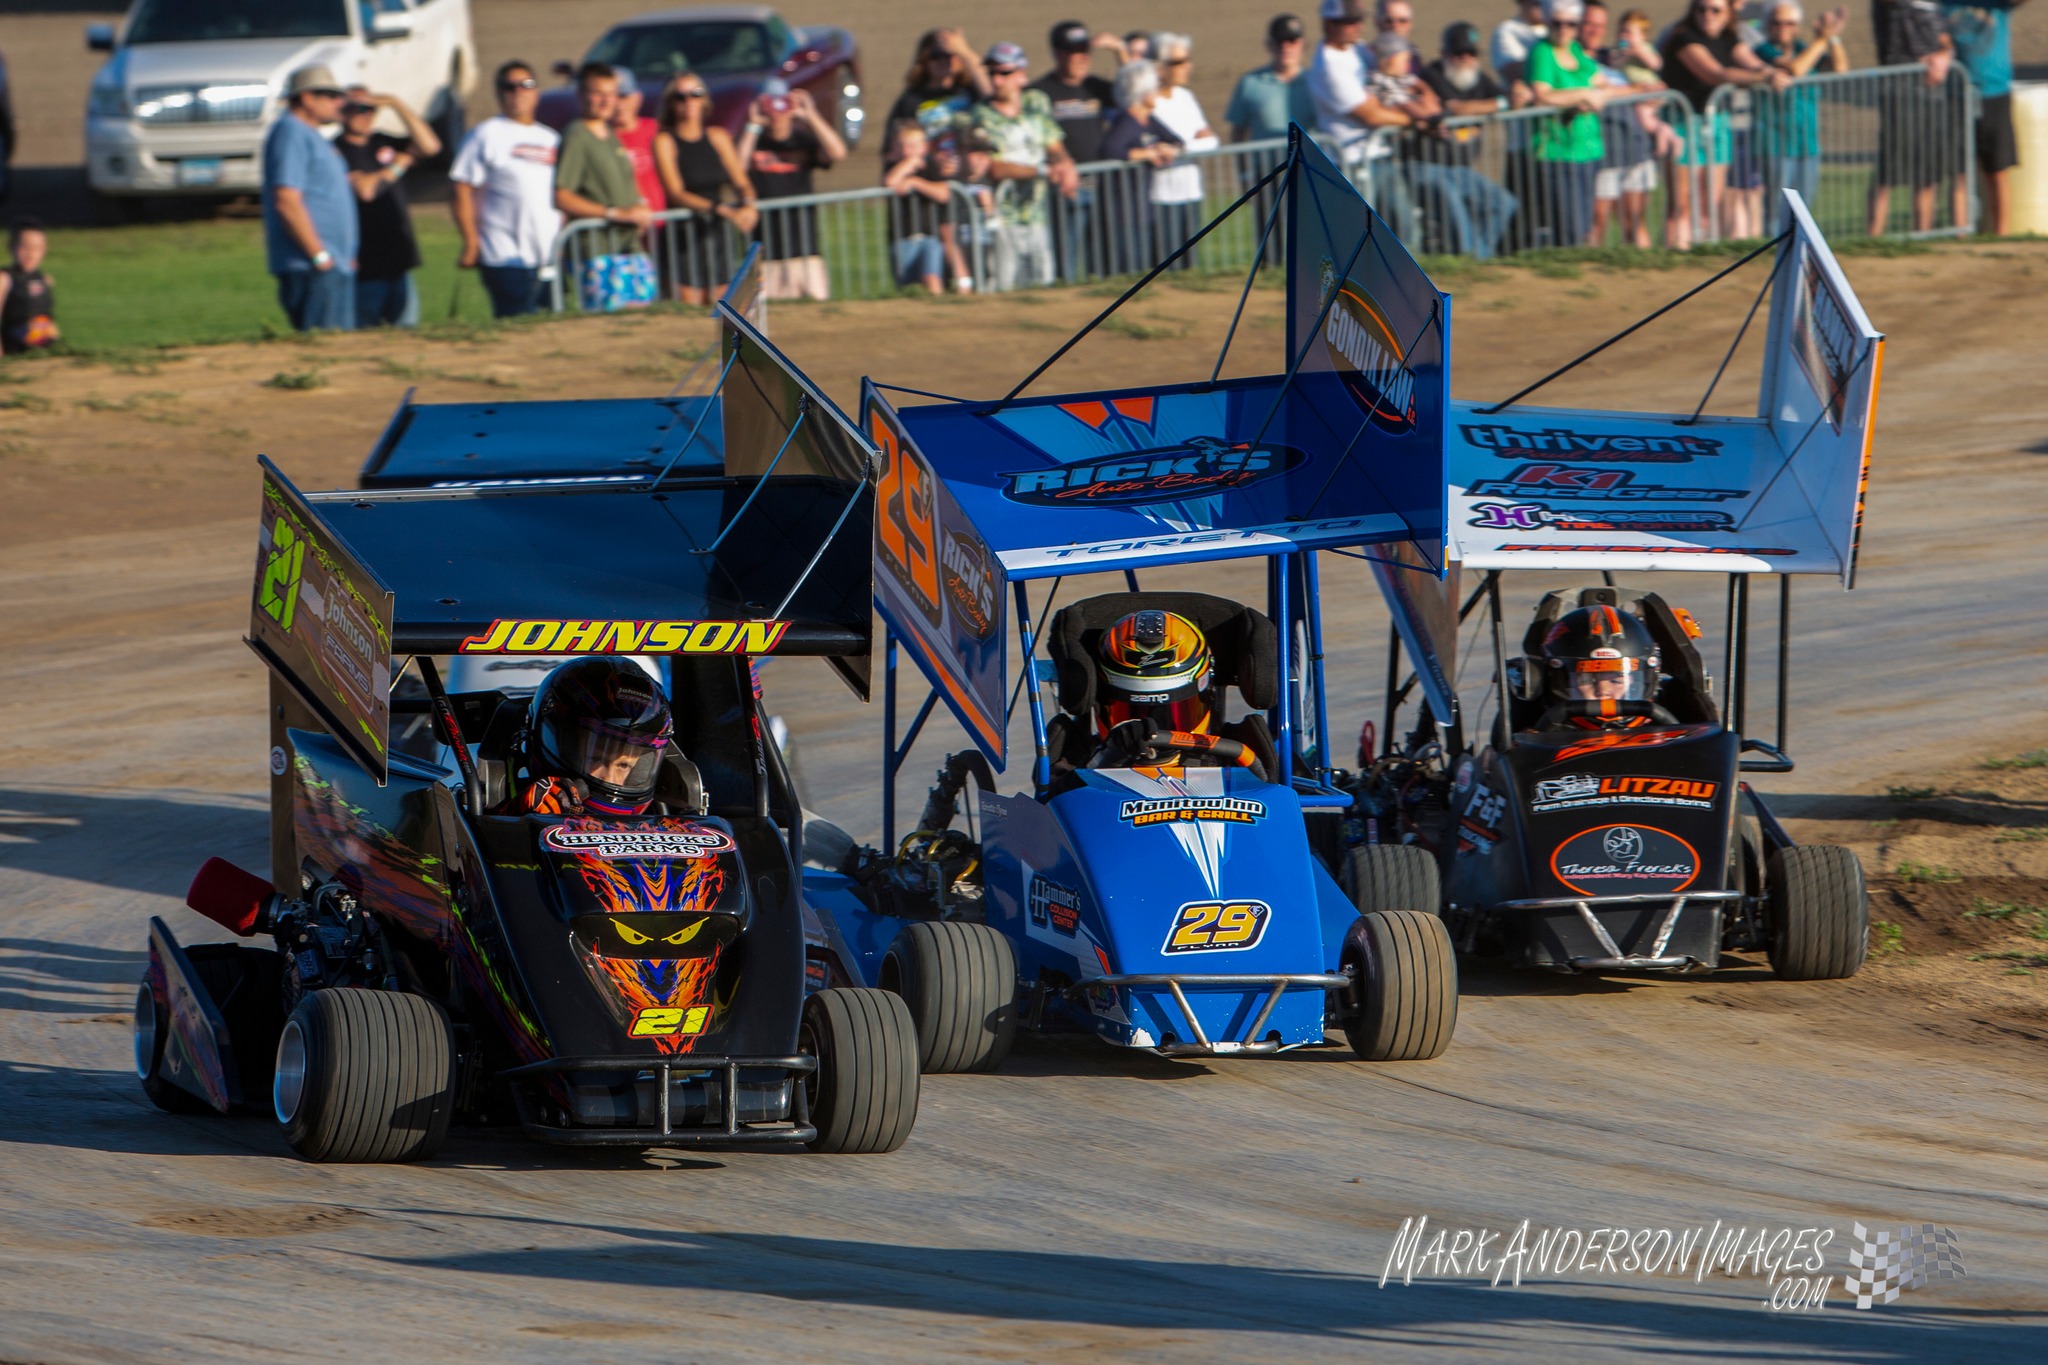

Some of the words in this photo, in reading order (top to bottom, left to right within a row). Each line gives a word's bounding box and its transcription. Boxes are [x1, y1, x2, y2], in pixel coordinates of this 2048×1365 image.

[1327, 300, 1382, 386] GONDIK
[1378, 350, 1414, 416] LAW
[1470, 427, 1724, 453] thrivent
[1010, 450, 1271, 494] RICK'S
[1055, 480, 1144, 498] Auto
[1153, 471, 1257, 490] Body
[1513, 465, 1627, 489] K1
[872, 409, 939, 609] 29
[1539, 511, 1727, 523] HOOSIER
[1046, 519, 1365, 558] TORETTO
[259, 515, 305, 634] 21
[326, 591, 373, 663] Johnson
[459, 619, 791, 653] JOHNSON
[325, 634, 369, 694] FARMS
[1599, 777, 1715, 798] LITZAU
[1122, 797, 1222, 818] Manitou
[1223, 797, 1263, 815] Inn
[1134, 810, 1177, 825] BAR
[1180, 811, 1194, 820] &
[1197, 810, 1253, 822] GRILL
[563, 834, 720, 845] HENDRICKS
[600, 844, 702, 856] FARMS
[1031, 879, 1081, 919] Hammer's
[1049, 903, 1077, 919] COLLISION
[1053, 915, 1073, 928] CENTER
[1172, 905, 1257, 946] 29
[632, 1006, 709, 1035] 21
